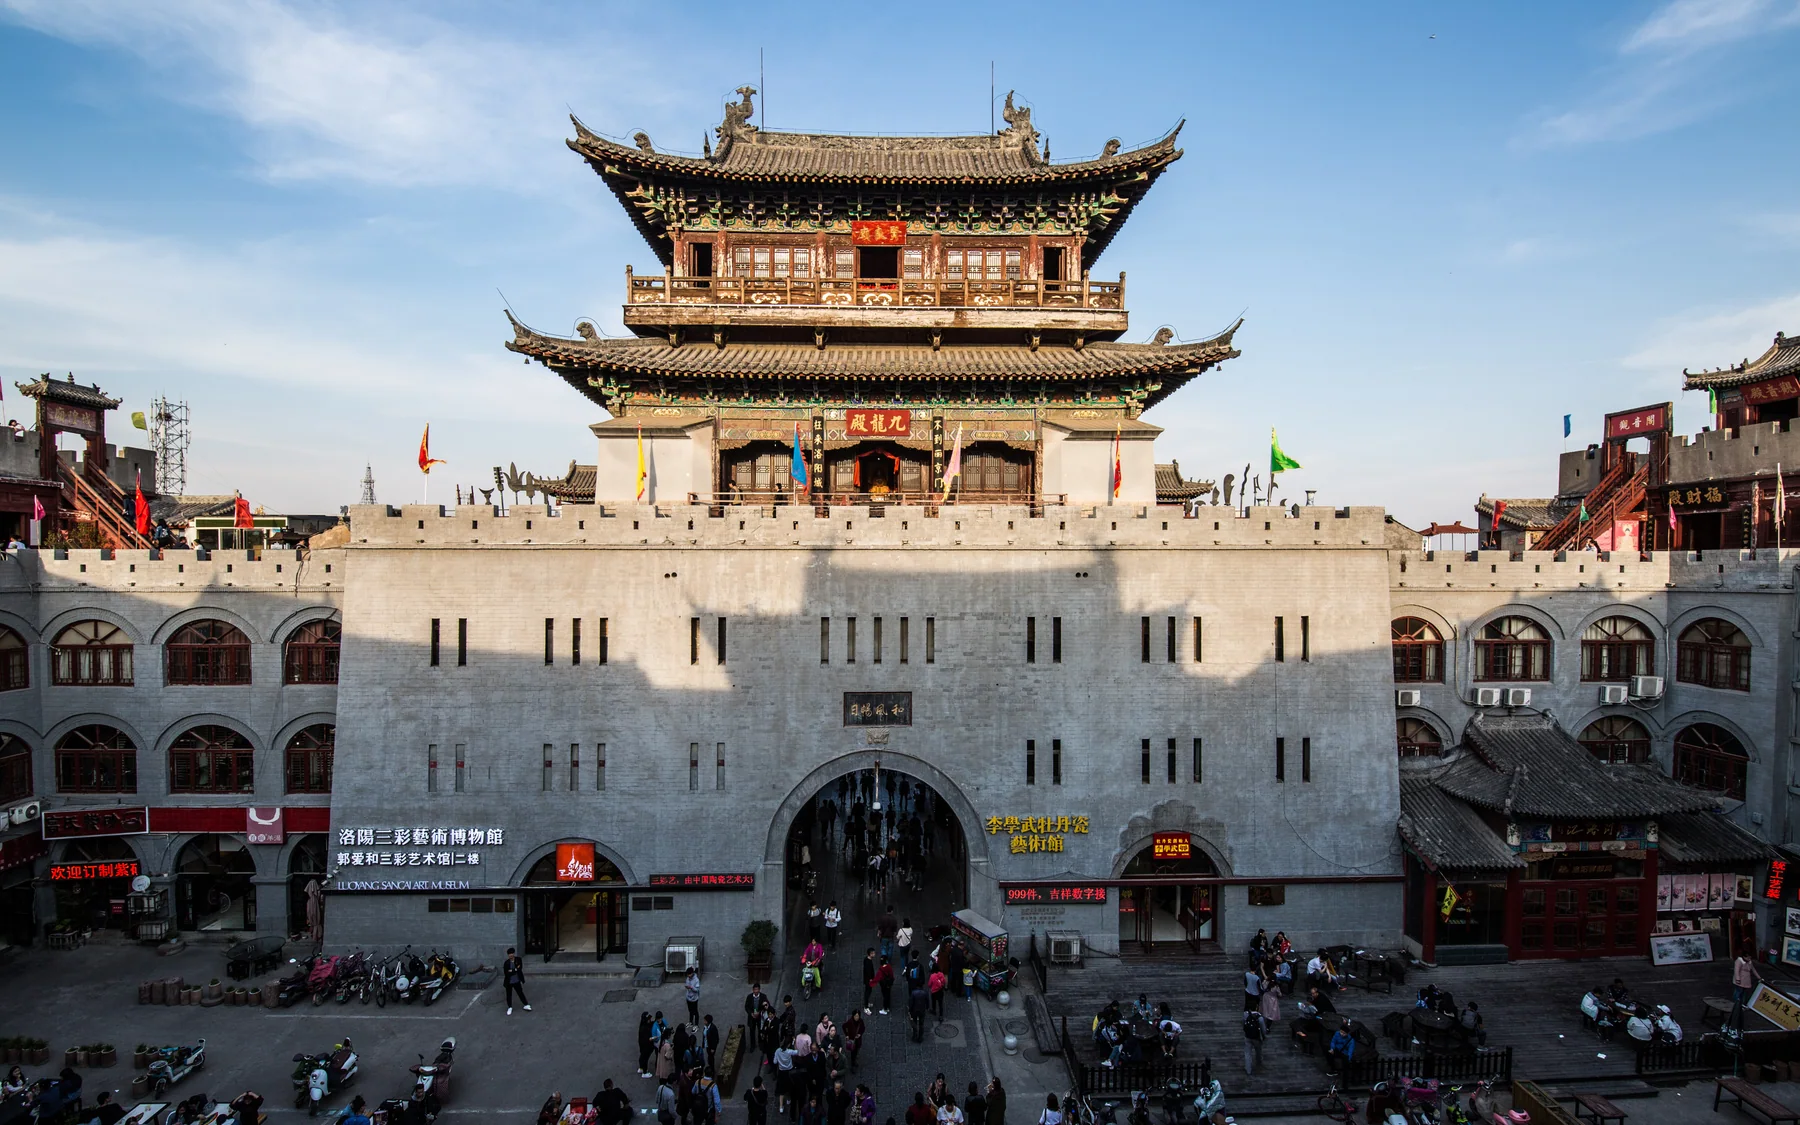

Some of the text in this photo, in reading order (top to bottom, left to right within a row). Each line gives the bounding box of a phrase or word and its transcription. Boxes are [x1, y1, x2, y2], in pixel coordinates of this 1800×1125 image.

[850, 414, 906, 432] 九龍殿
[985, 815, 1089, 834] 李學武牡丹瓷
[338, 828, 504, 846] 洛陽三彩藝術博物館
[1010, 834, 1064, 854] 藝術館
[431, 881, 470, 889] MUSEUM
